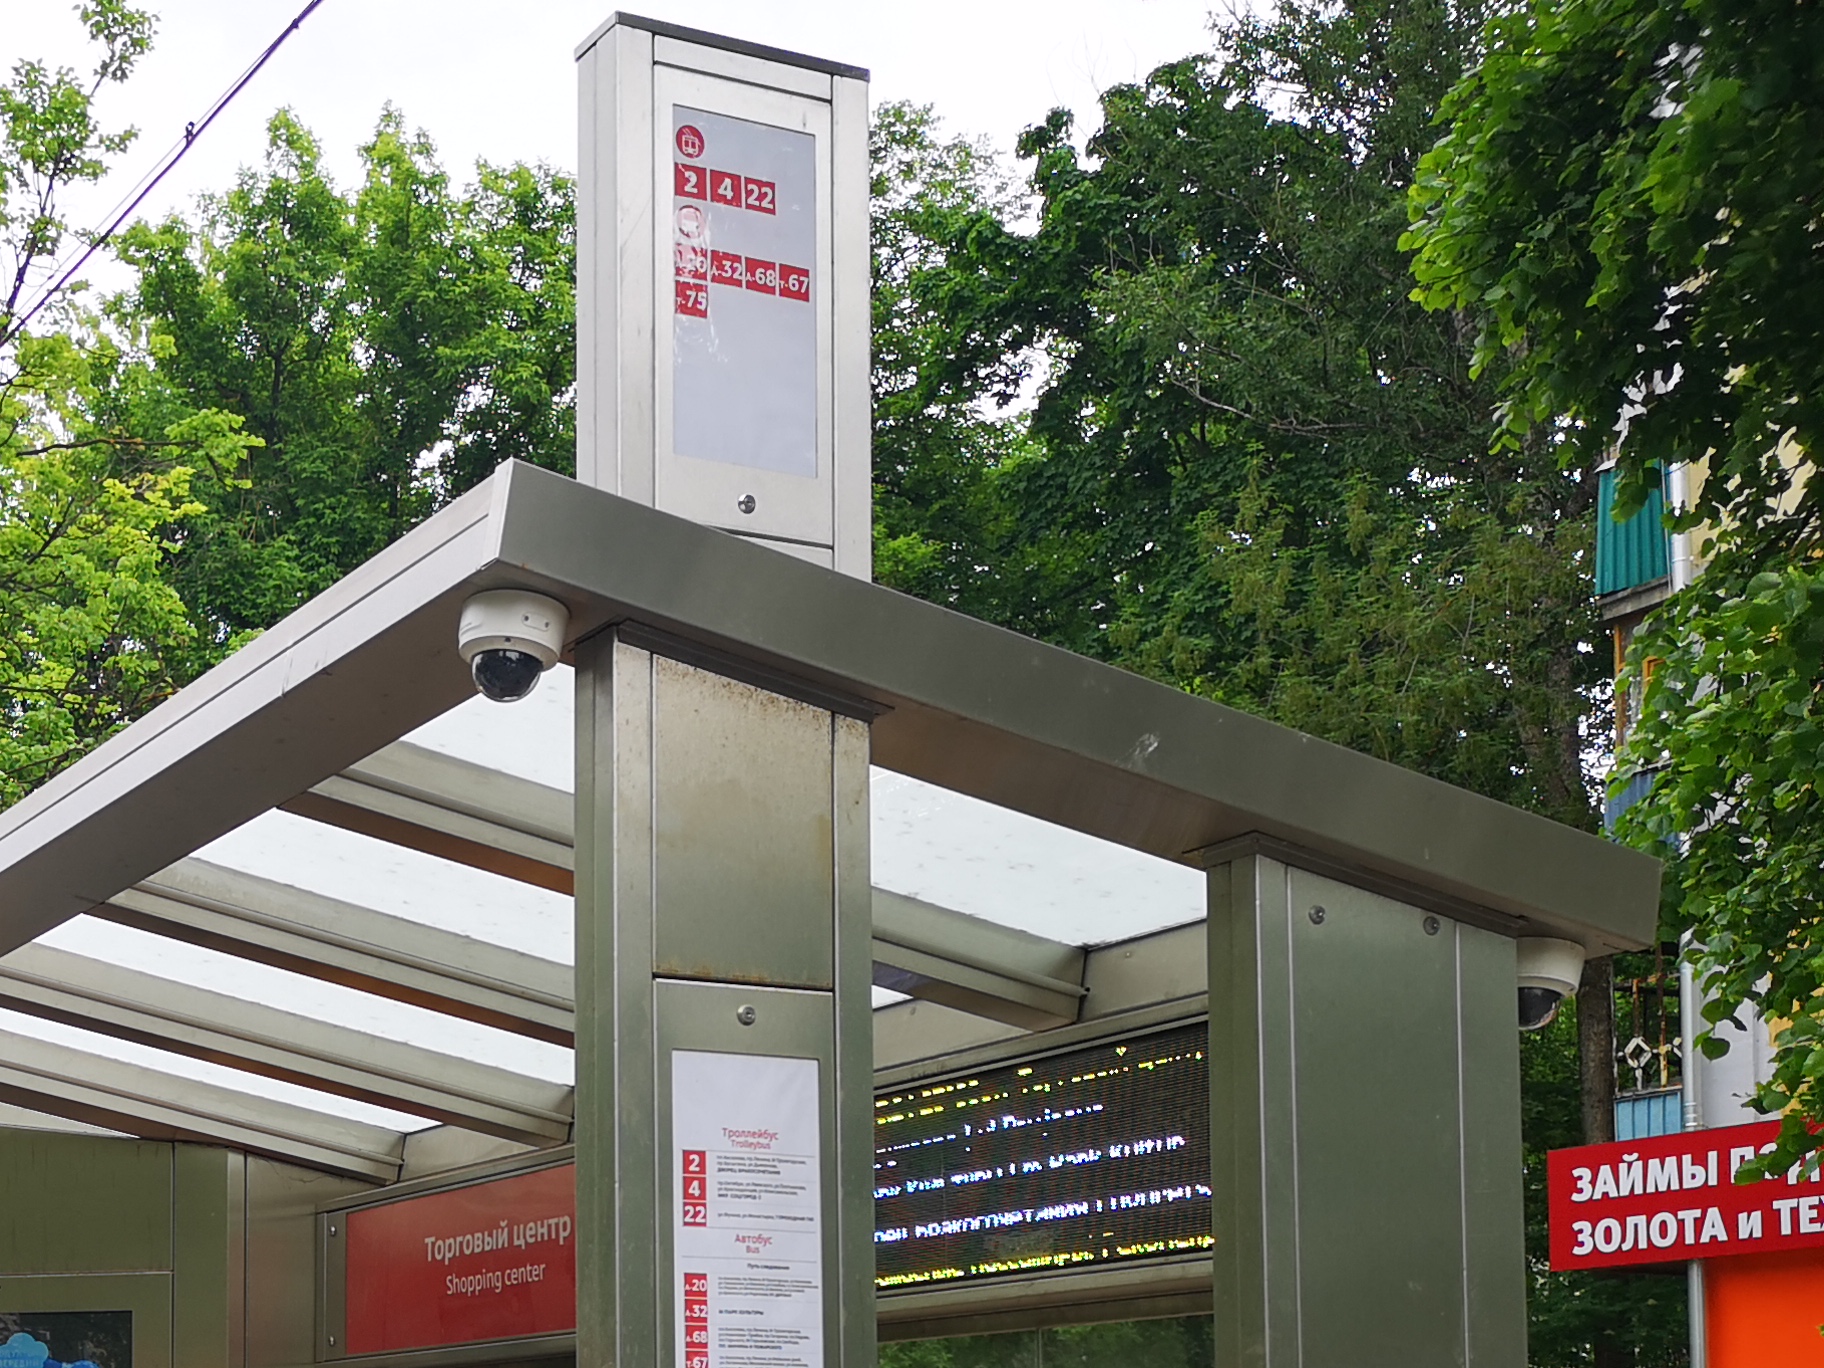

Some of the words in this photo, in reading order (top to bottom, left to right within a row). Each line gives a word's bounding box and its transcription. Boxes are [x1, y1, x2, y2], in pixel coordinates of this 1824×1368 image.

[684, 171, 698, 193] 2
[717, 178, 734, 200] 4
[747, 184, 774, 209] 22
[722, 1127, 779, 1142] Троллейбус
[731, 1140, 771, 1150] Trolleybus
[689, 1154, 700, 1172] 2
[1571, 1150, 1718, 1202] ЗАЙМЫ
[688, 1180, 701, 1197] 4
[684, 1205, 706, 1223] 22
[425, 1219, 508, 1265] Торговый
[513, 1215, 571, 1250] центр
[735, 1233, 773, 1247] Автобус
[1572, 1207, 1728, 1256] ЗОЛОТА
[1738, 1210, 1763, 1240] и
[746, 1245, 760, 1254] Bus
[446, 1269, 502, 1297] Shopping
[504, 1263, 546, 1285] center
